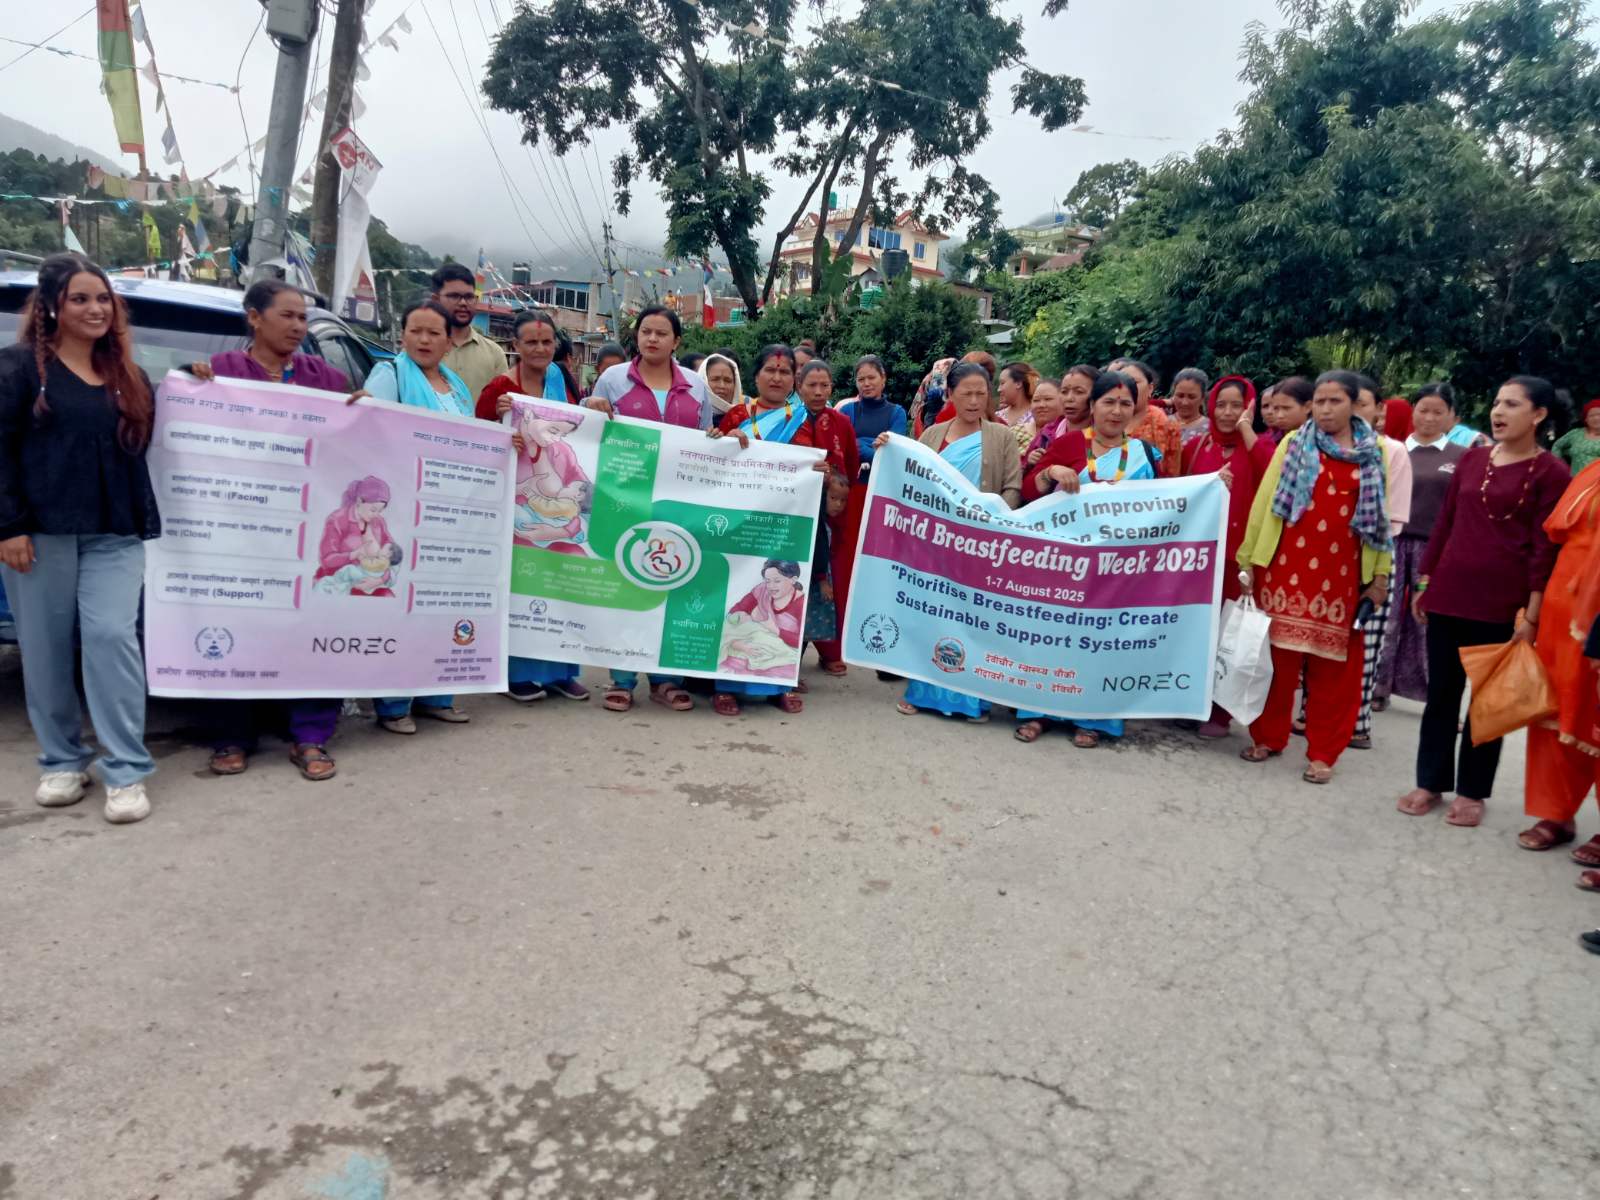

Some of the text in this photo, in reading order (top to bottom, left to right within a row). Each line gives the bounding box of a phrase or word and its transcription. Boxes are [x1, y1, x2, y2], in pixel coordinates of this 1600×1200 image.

[227, 490, 268, 504] (Facing)
[902, 484, 949, 513] Health
[1099, 522, 1180, 540] Scenario
[1051, 508, 1078, 529] for
[1084, 497, 1187, 518] Improving
[883, 503, 930, 540] World
[932, 522, 1090, 580] Breastfeeding
[1098, 549, 1151, 575] Week
[1153, 547, 1209, 572] 2025
[213, 588, 263, 600] (Support)
[985, 575, 1085, 602] 1-7 August 2025
[896, 591, 990, 631] Sustainable
[996, 622, 1071, 648] Support
[973, 592, 1112, 629] Breastfeeding:
[1119, 611, 1179, 626] Create
[1102, 672, 1190, 692] NOREC
